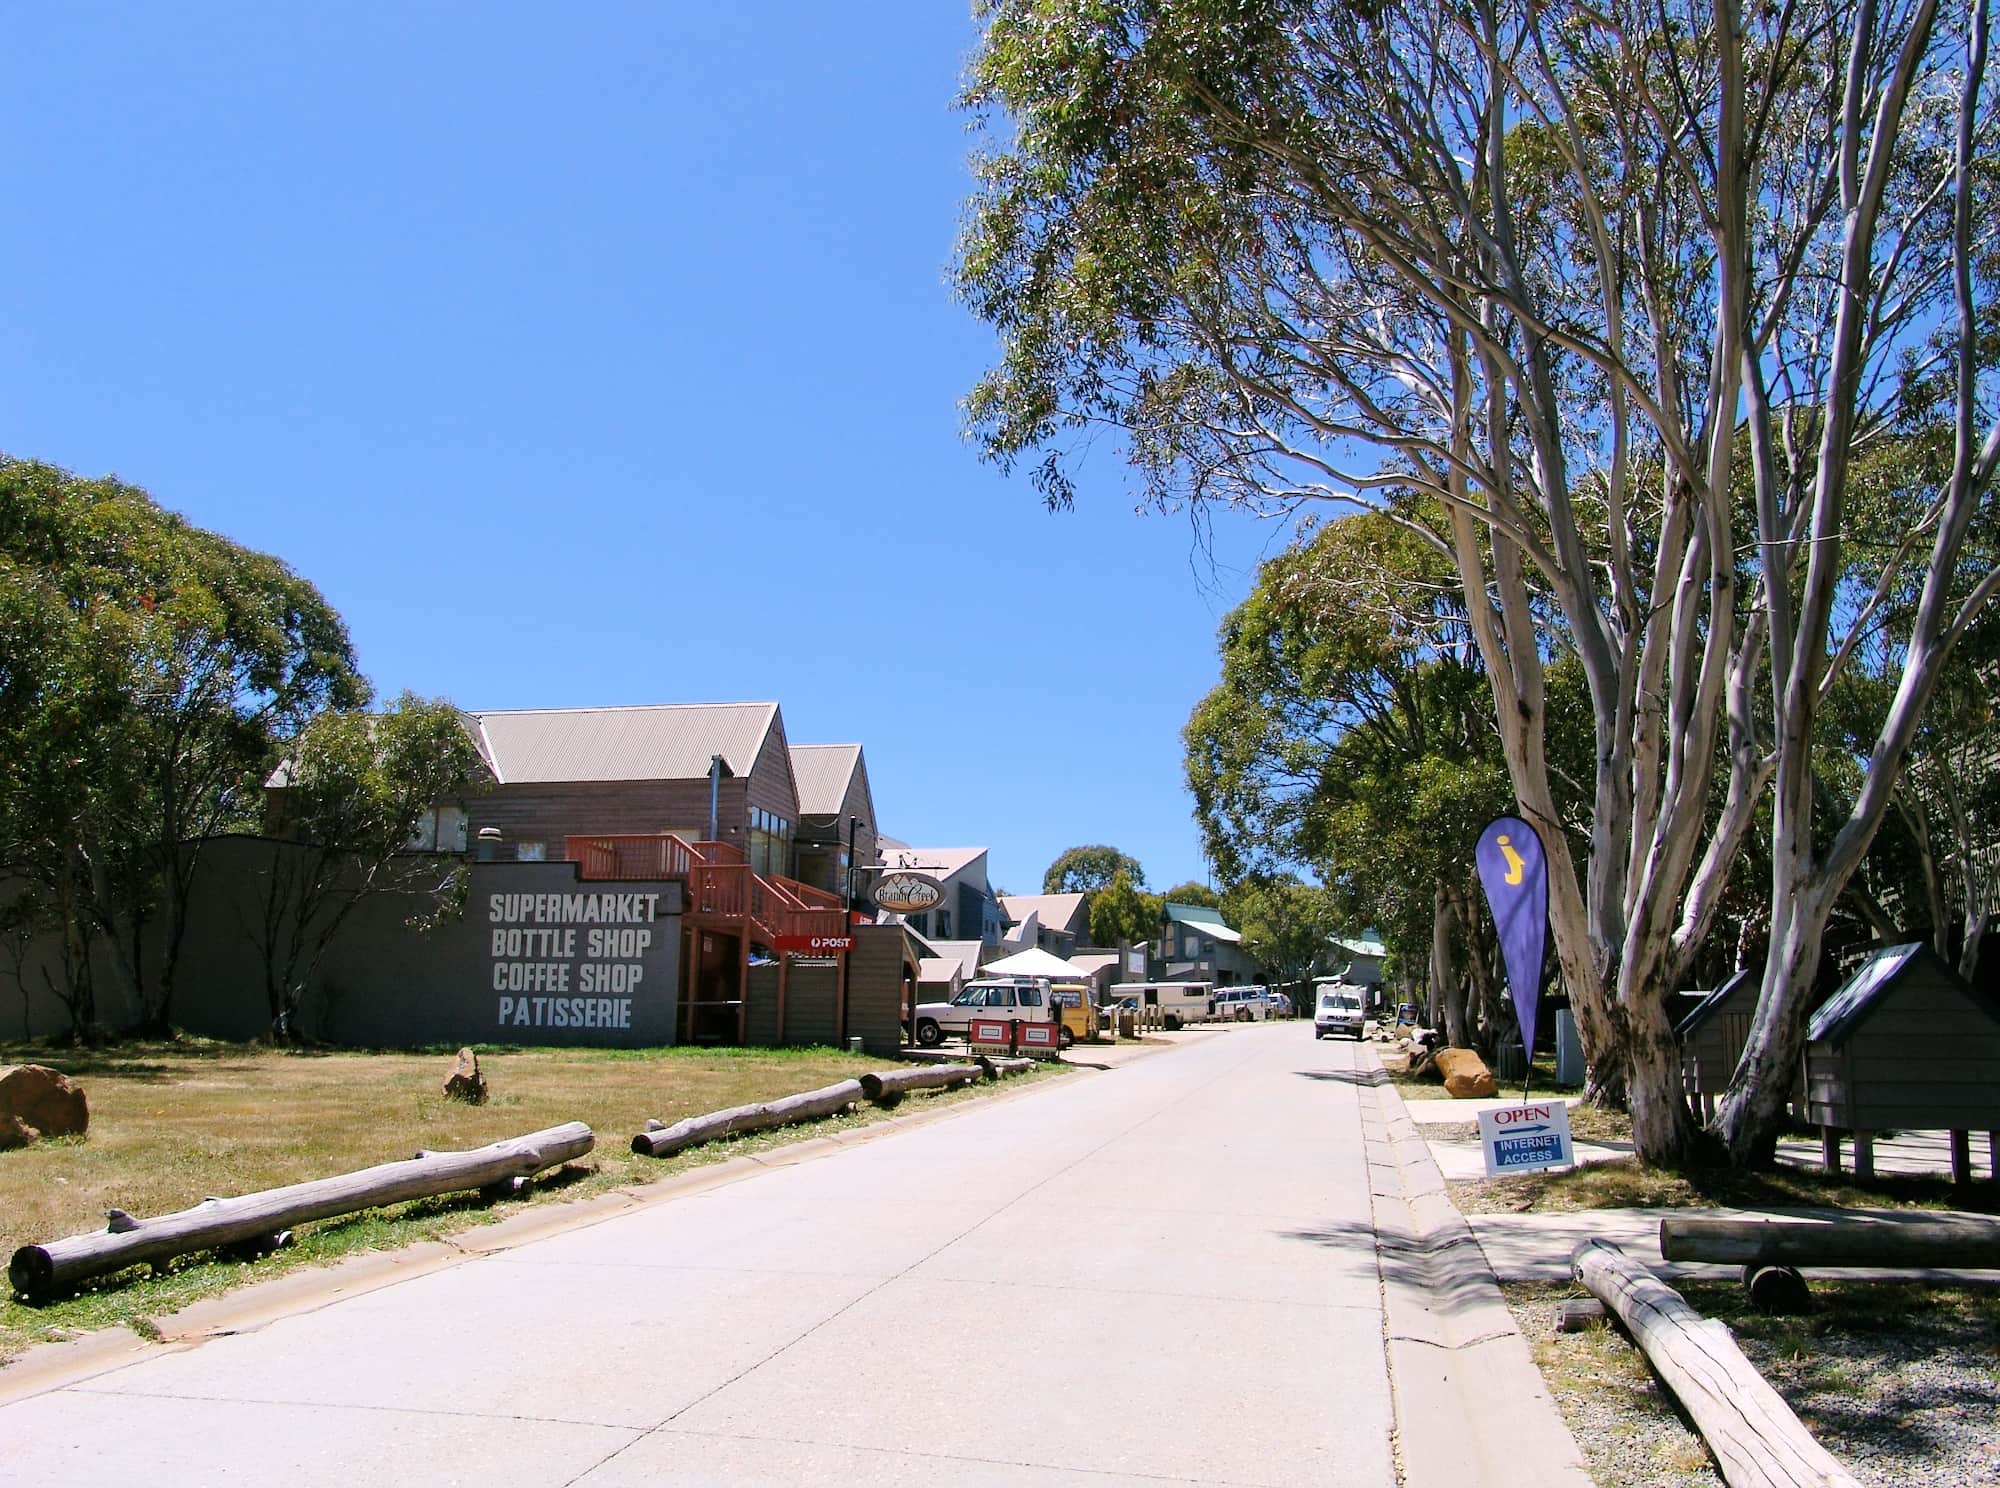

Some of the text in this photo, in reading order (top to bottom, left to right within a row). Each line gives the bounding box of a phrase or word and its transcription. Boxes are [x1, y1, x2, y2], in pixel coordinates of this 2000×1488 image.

[908, 884, 934, 905] Creek
[489, 893, 659, 923] SUPERMARKET
[492, 928, 651, 958] BOTTLE SHOP
[822, 938, 851, 947] POST
[493, 962, 643, 993] COFFEE SHOP
[498, 997, 632, 1028] PATISSERIE
[1494, 1106, 1550, 1125] OPEN
[1500, 1135, 1559, 1151] INTERNET
[1503, 1150, 1553, 1165] ACCESS
